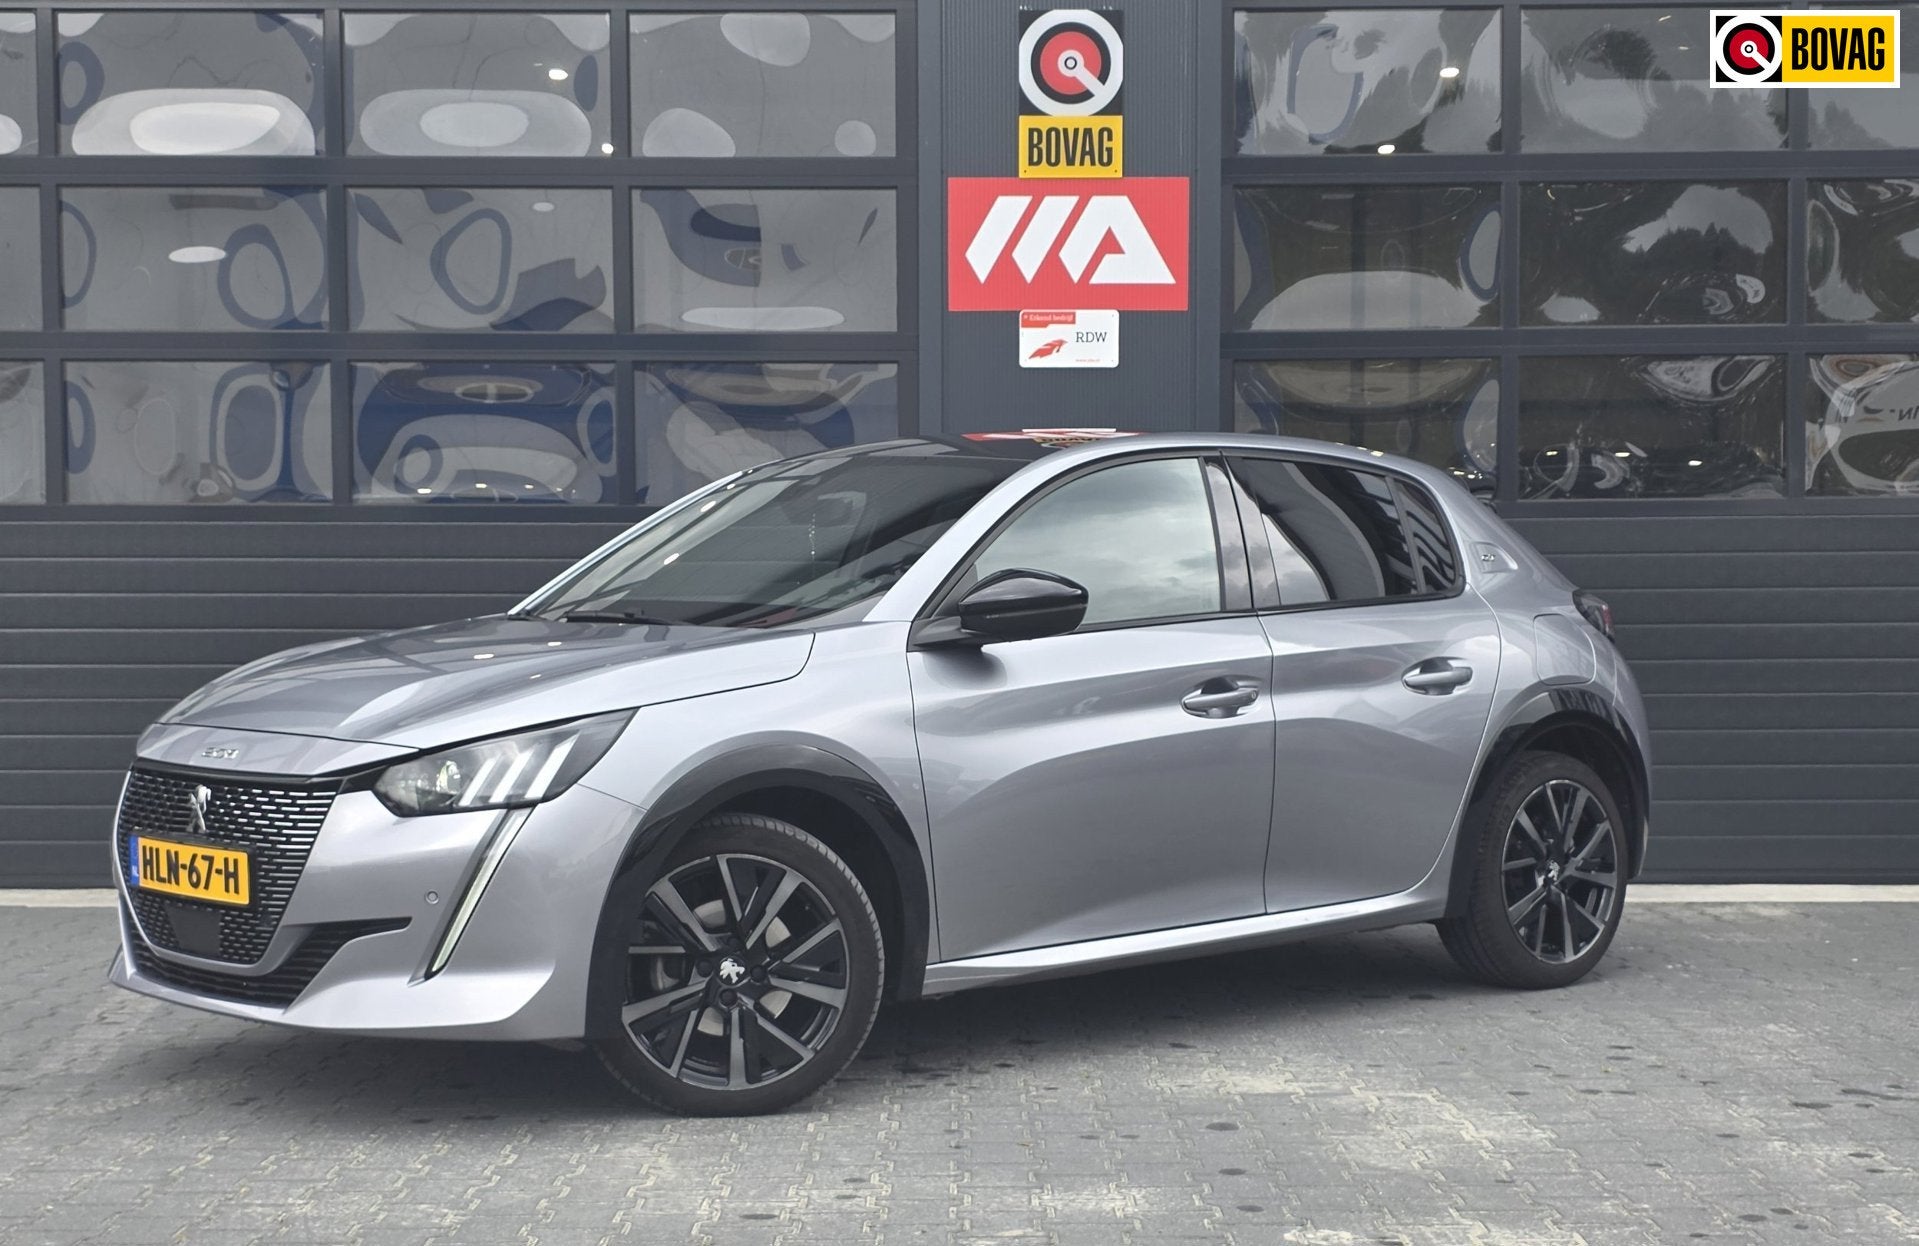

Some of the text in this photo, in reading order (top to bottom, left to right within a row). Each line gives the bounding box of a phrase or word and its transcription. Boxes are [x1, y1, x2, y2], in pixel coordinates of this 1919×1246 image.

[1028, 127, 1113, 166] BOVAG
[1075, 332, 1108, 343] RDW
[142, 846, 240, 895] HLN-67-H
